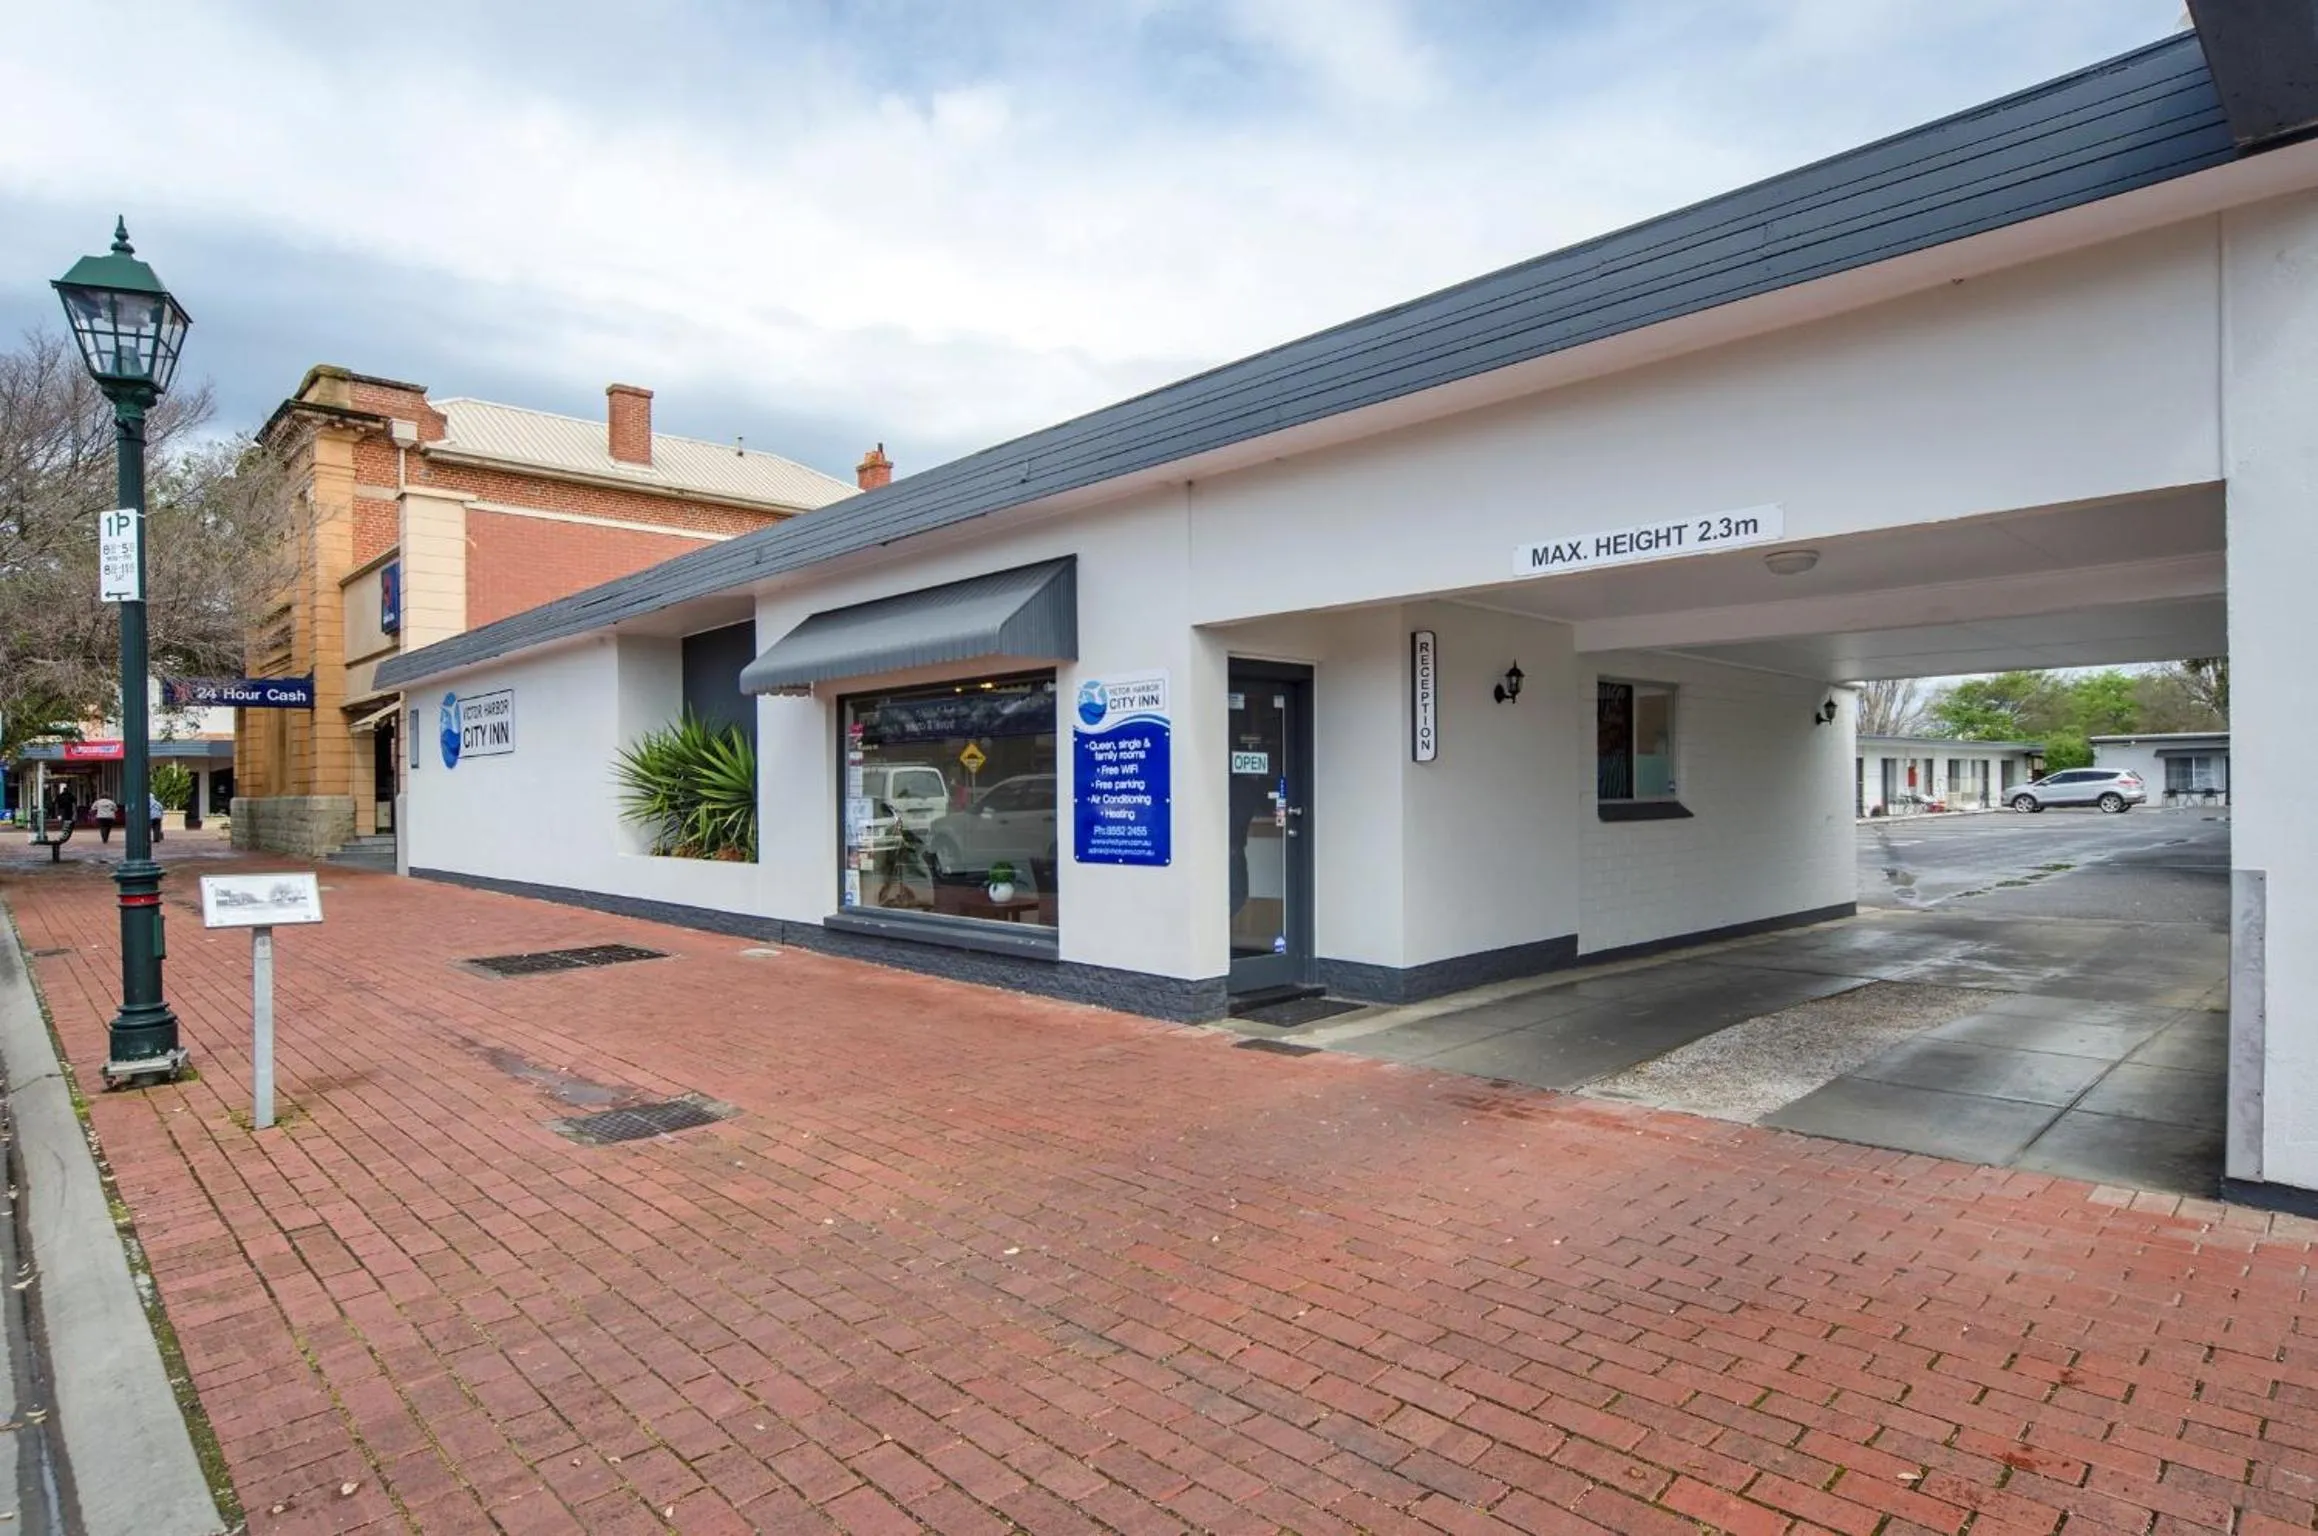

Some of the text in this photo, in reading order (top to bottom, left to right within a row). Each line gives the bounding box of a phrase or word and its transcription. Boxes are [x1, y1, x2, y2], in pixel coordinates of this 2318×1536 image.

[106, 514, 130, 537] 1P
[1531, 517, 1759, 567] MAX. HEIGHT 2.3m
[197, 687, 307, 702] 24 Hour Cash
[1109, 694, 1159, 709] CITY INN
[1420, 642, 1431, 750] RECEPTION
[484, 699, 509, 715] HARBOR
[463, 721, 509, 748] CITY INN
[1119, 739, 1141, 750] single
[1143, 738, 1151, 748] &
[1095, 750, 1146, 762] family rooms
[1234, 755, 1266, 770] OPEN
[1101, 764, 1119, 776] Free
[1095, 780, 1145, 791] Free parking
[1090, 794, 1152, 806] Air Conditioning
[1105, 808, 1135, 821] Heating
